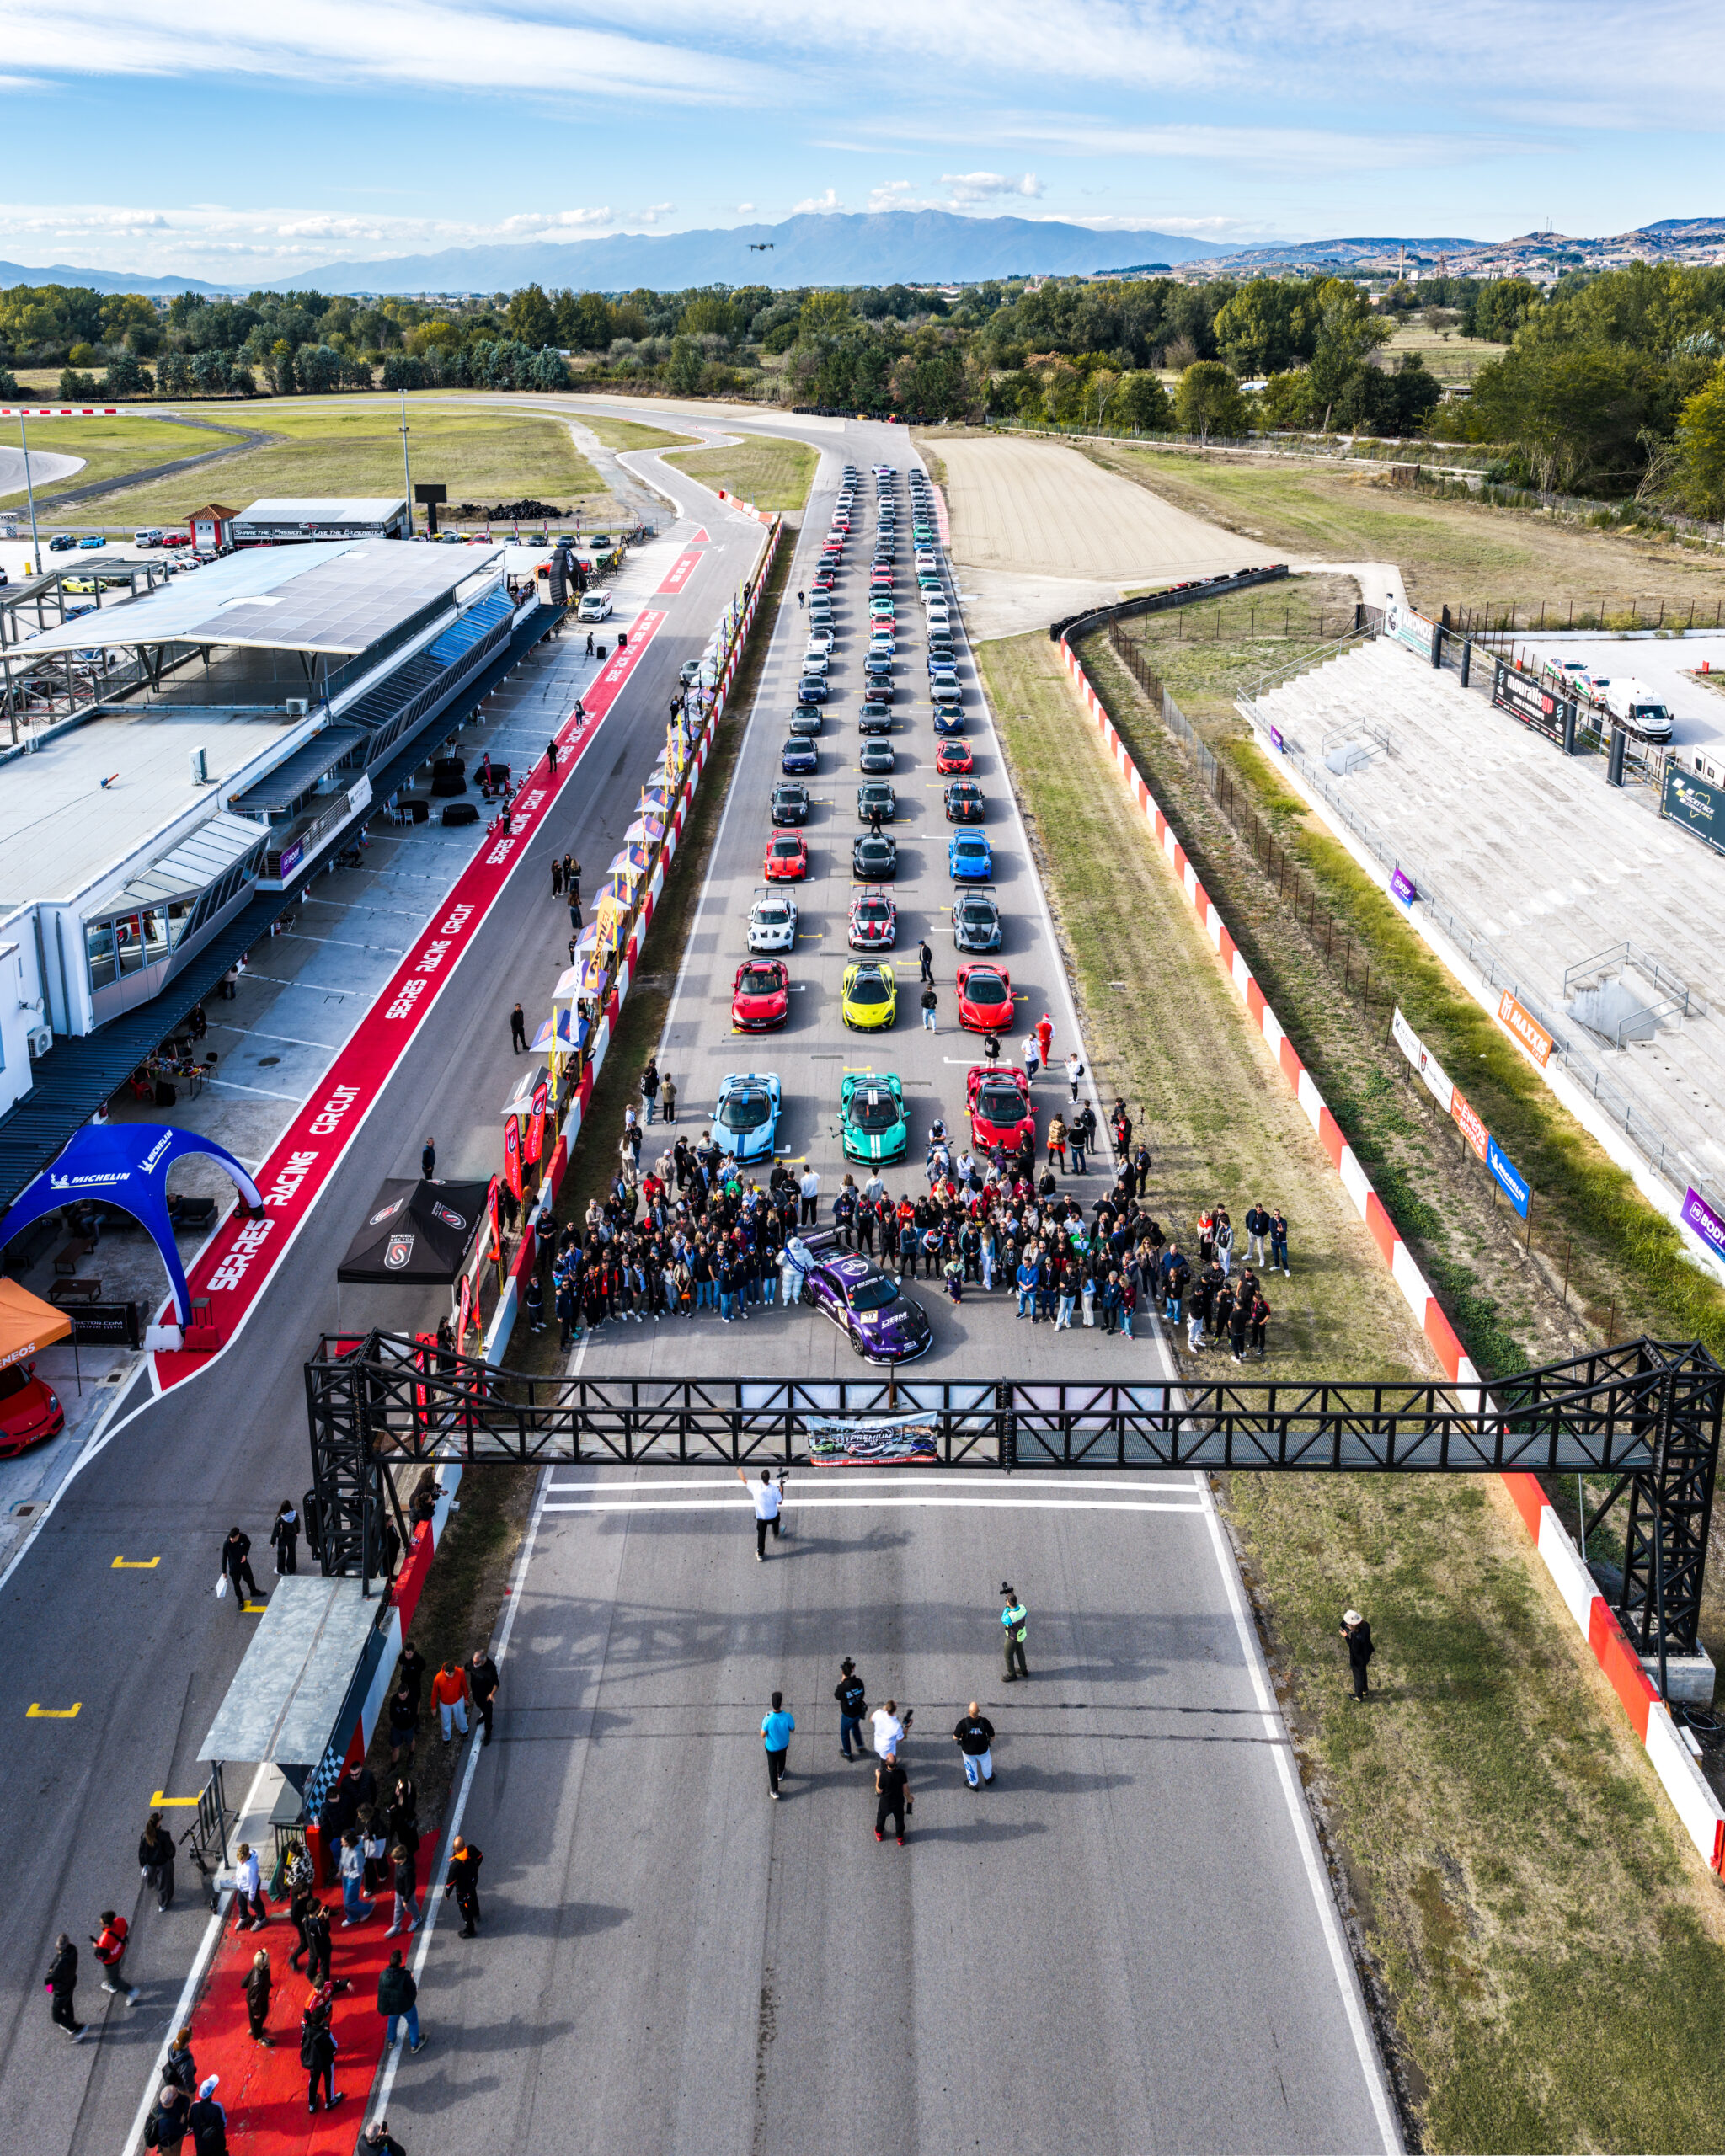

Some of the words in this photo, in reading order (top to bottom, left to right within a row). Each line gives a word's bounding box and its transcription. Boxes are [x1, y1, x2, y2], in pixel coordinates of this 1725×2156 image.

[1402, 611, 1433, 640] KRONOS
[485, 839, 516, 864] SERRES
[521, 789, 547, 809] CIRCUIT
[384, 979, 428, 1019] SERRES
[414, 940, 453, 972] RACING
[440, 903, 475, 934] CIRCUIT
[1510, 1010, 1548, 1056] MAXXIS
[1459, 1118, 1477, 1145] MOTOR
[1475, 1139, 1485, 1156] OIL
[1461, 1103, 1486, 1145] ENEOS
[147, 1129, 174, 1163] MICHELIN
[71, 1172, 131, 1184] MICHELIN
[206, 1218, 275, 1291] SERRES
[263, 1150, 319, 1206] RACING
[308, 1084, 361, 1135] CIRCUIT
[1498, 1162, 1525, 1202] MICHELIN
[1701, 1214, 1725, 1245] BODY
[882, 1311, 908, 1328] DBM
